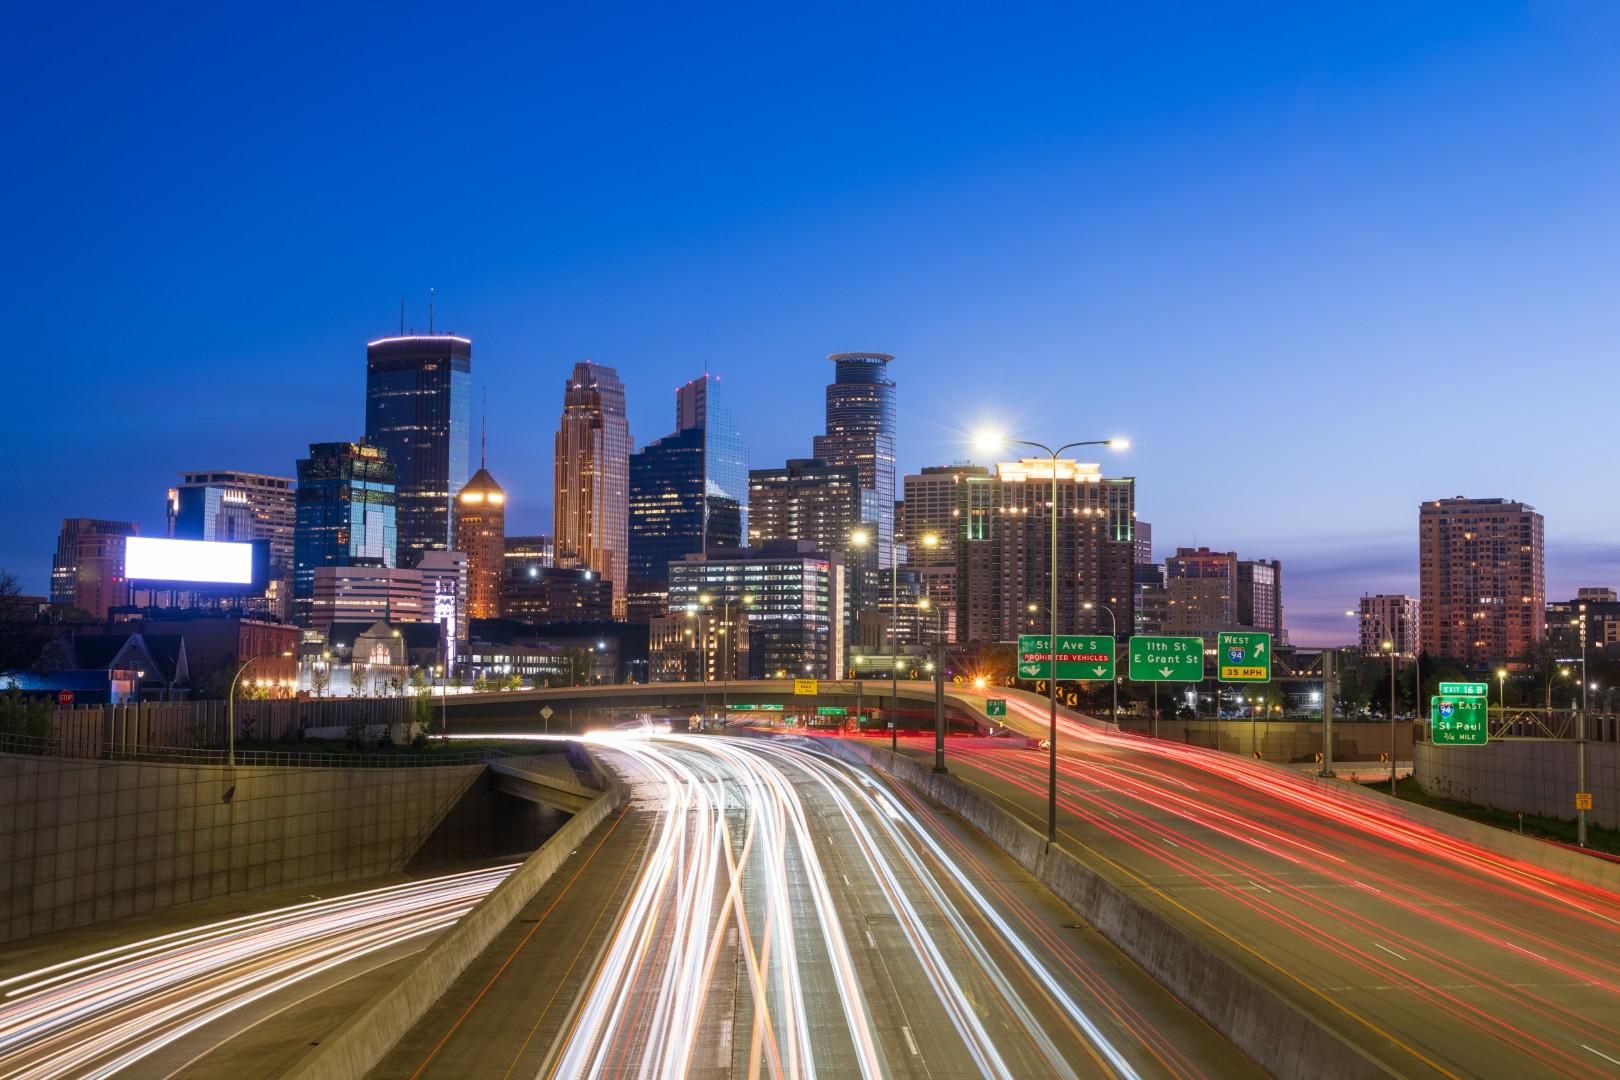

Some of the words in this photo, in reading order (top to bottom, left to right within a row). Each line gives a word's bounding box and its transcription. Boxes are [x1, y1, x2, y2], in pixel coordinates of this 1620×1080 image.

[1224, 636, 1248, 644] WEST
[1062, 641, 1084, 650] Ave
[1090, 642, 1096, 650] S
[1146, 642, 1168, 650] 11th
[1174, 642, 1186, 650] St
[1134, 654, 1141, 662] E
[1148, 654, 1180, 663] Grant
[1186, 654, 1198, 664] St
[1230, 652, 1242, 660] 94
[1464, 686, 1474, 694] 16
[1476, 686, 1482, 694] B
[1458, 701, 1482, 710] EAST
[1438, 722, 1450, 730] St
[1456, 722, 1480, 730] Paul
